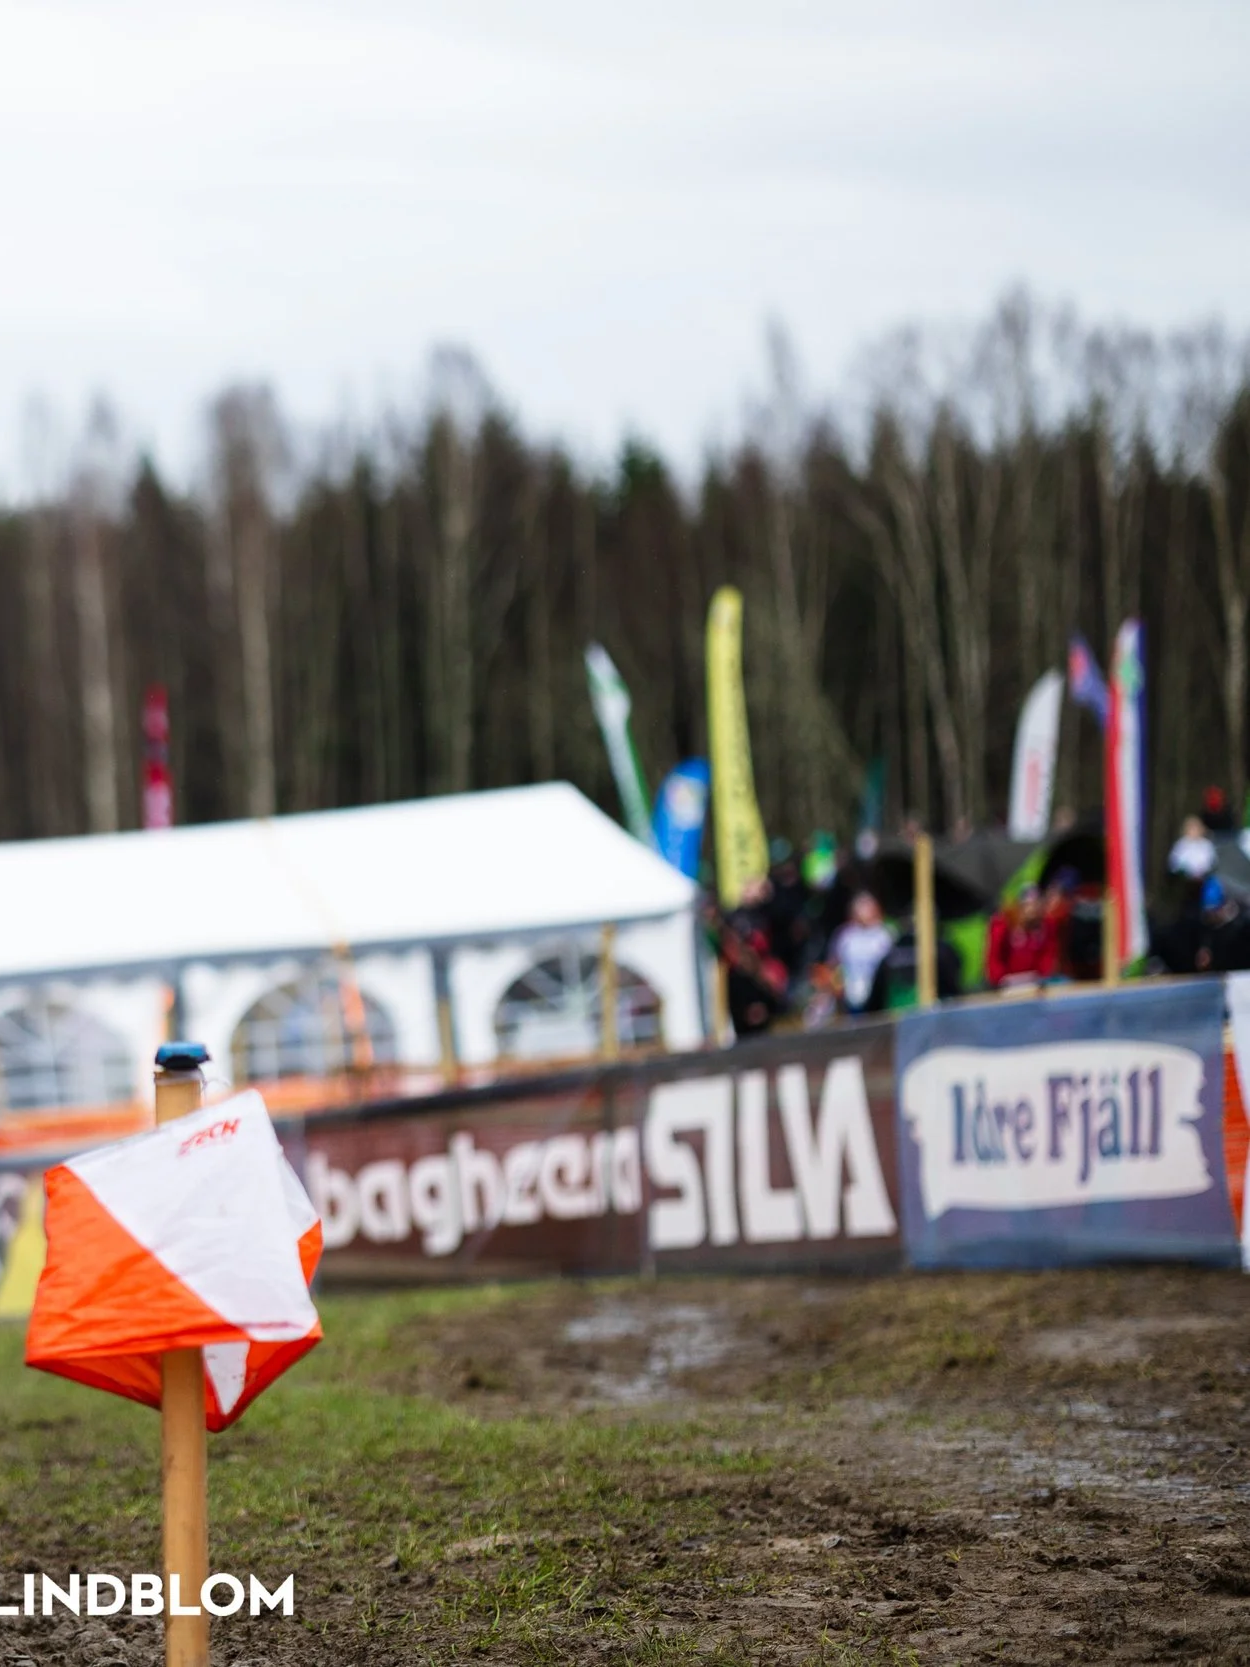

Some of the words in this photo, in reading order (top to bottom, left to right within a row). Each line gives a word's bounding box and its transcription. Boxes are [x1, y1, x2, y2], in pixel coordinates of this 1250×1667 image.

[309, 1125, 641, 1257] bagheera
[646, 1057, 899, 1251] SILVA
[949, 1078, 1034, 1168] Idre
[1047, 1066, 1163, 1185] Fjäll
